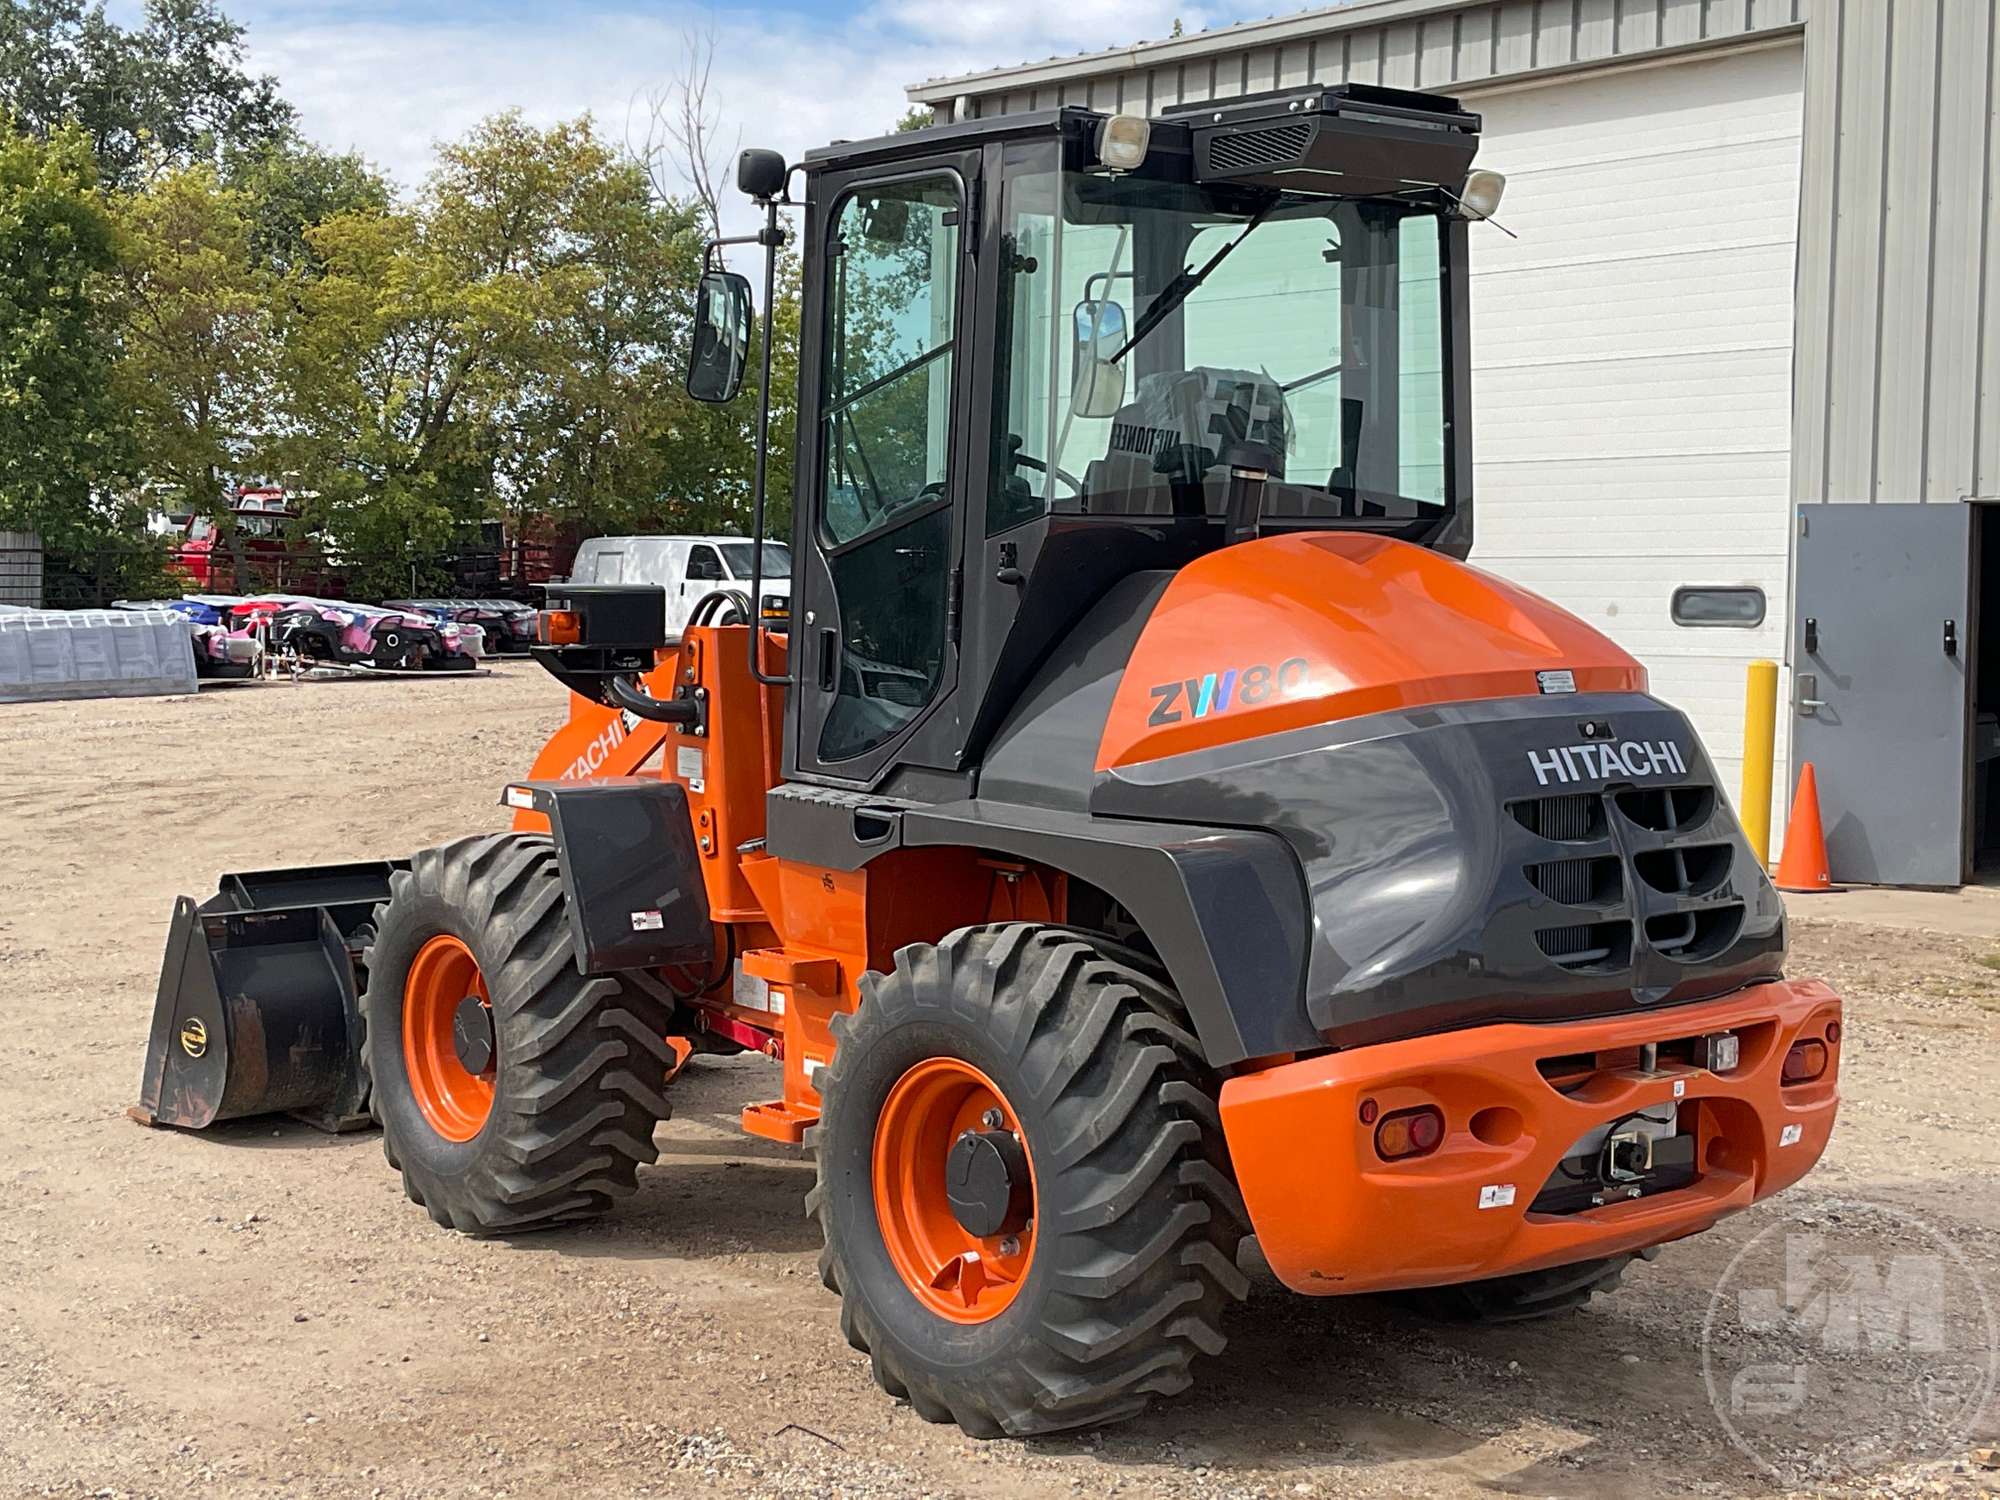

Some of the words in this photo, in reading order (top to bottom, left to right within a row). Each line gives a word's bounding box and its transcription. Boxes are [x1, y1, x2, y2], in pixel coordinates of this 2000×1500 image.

[1148, 657, 1311, 728] ZW80
[559, 718, 623, 780] TACHI
[1527, 740, 1687, 786] HITACHI
